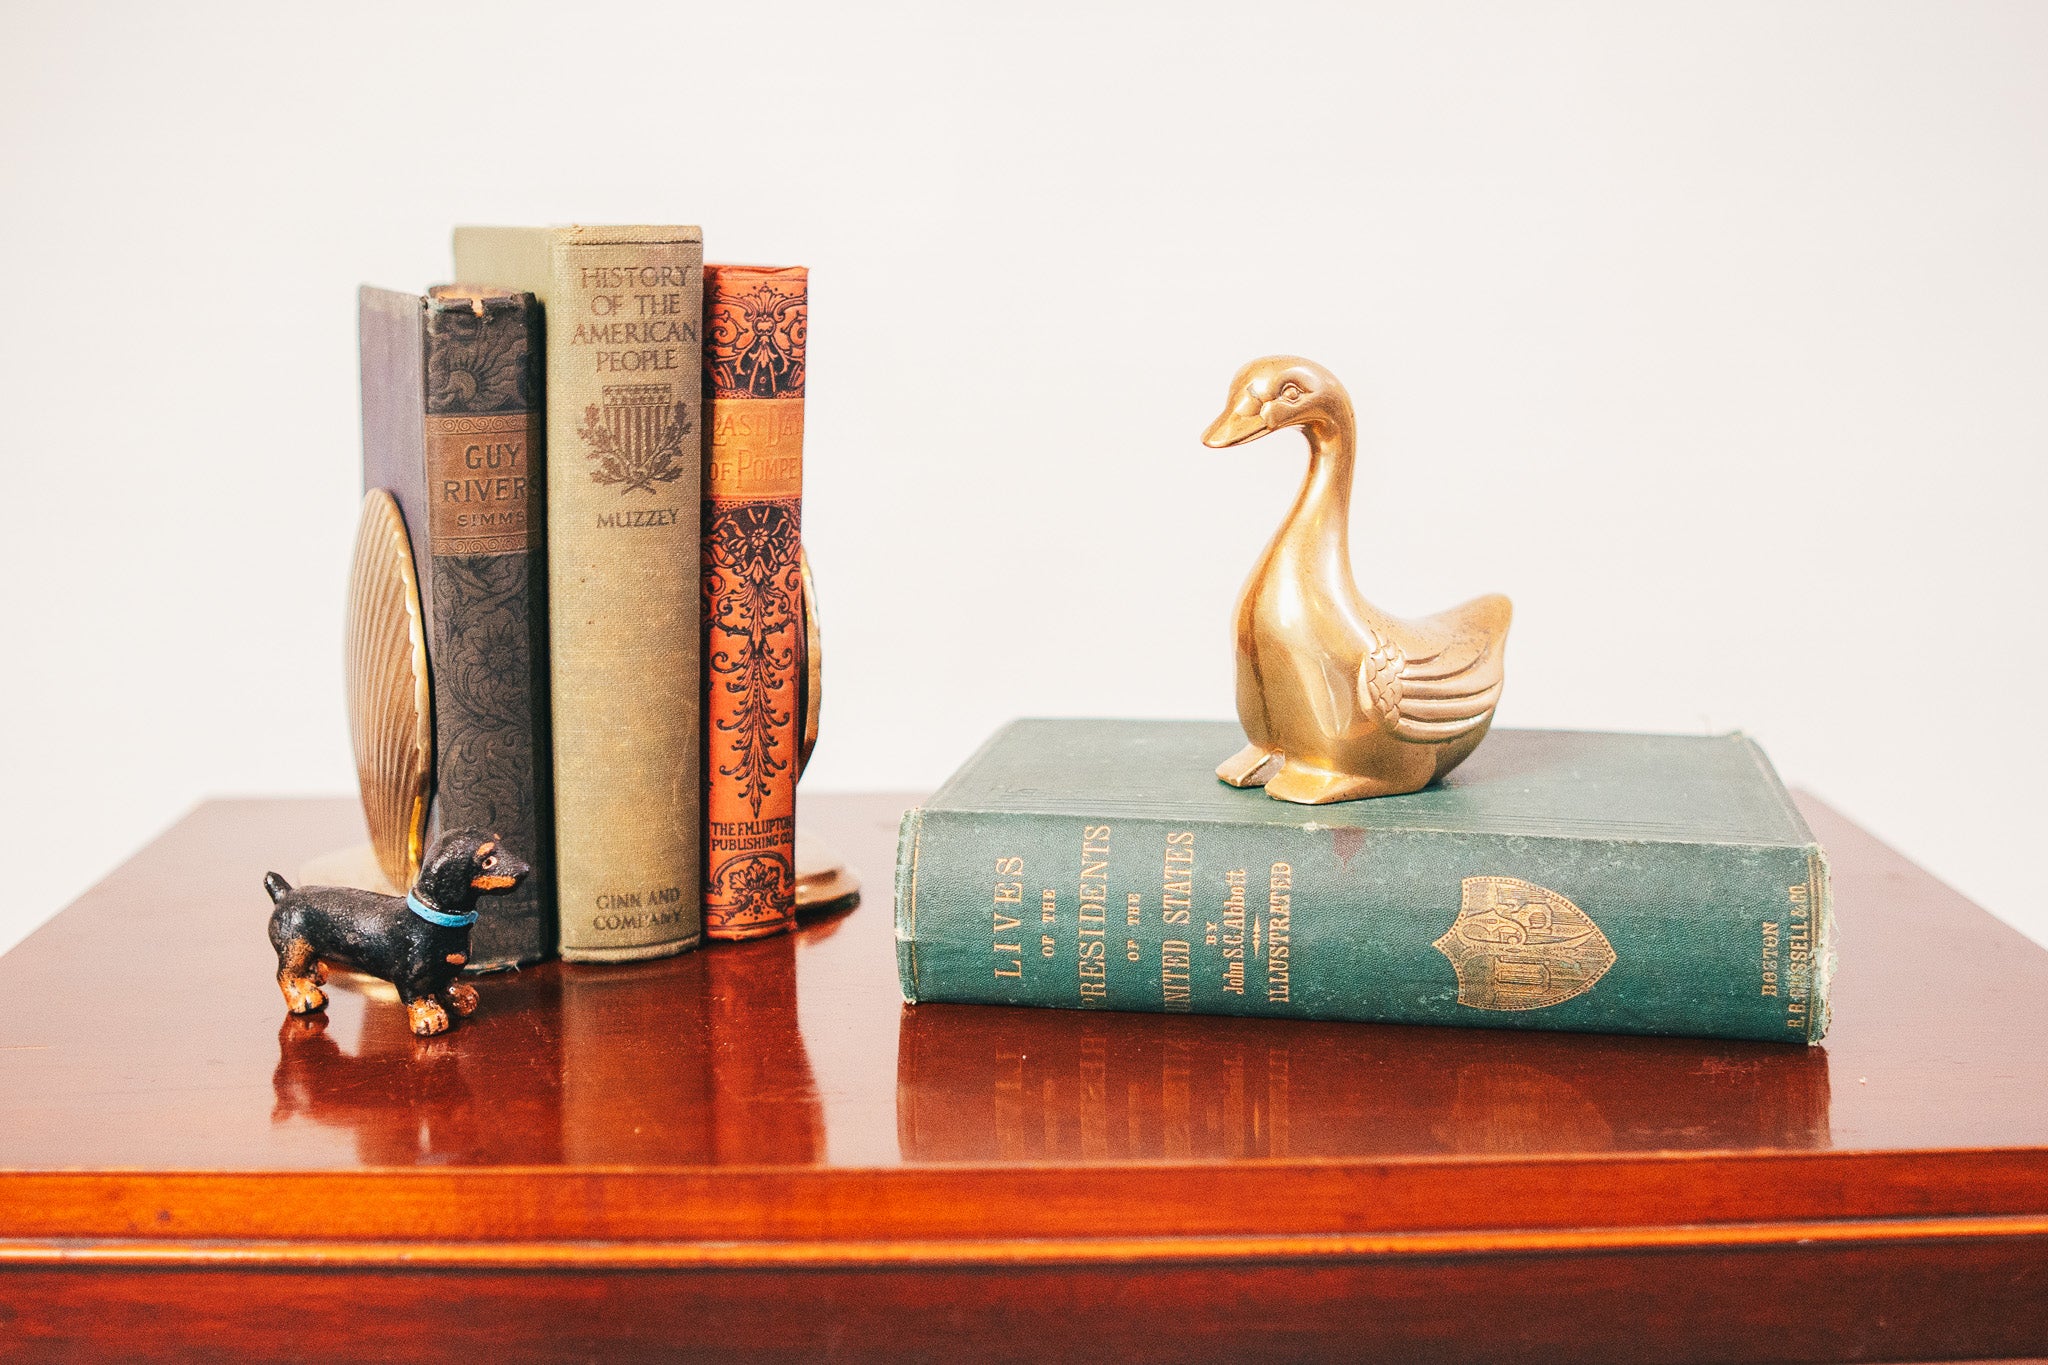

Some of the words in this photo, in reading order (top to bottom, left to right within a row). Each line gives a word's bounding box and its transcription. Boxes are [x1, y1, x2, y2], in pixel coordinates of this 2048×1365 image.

[582, 265, 691, 289] HISTORY
[590, 294, 624, 316] OF
[634, 293, 681, 315] THE
[570, 321, 698, 345] AMERICAN
[596, 349, 679, 373] PEOPLE
[465, 443, 521, 470] GUY
[709, 462, 734, 481] OF
[457, 510, 526, 528] SIMMS
[596, 509, 680, 529] MUZZEY
[711, 822, 736, 837] THE
[711, 834, 779, 852] PUBLISHING
[1163, 832, 1195, 925] STATES
[595, 893, 642, 910] GINN
[648, 887, 681, 906] AND
[1041, 888, 1056, 924] THE
[1127, 893, 1141, 926] THE
[592, 910, 681, 931] COMPANY
[993, 856, 1024, 979] LIVES
[1790, 904, 1809, 918] &
[1206, 921, 1219, 946] BY
[1268, 861, 1293, 1003] ILLUSTRATED
[1041, 934, 1056, 959] OF
[1127, 939, 1141, 962] OF
[1761, 921, 1779, 997] BOSTON
[1162, 940, 1191, 1012] UNITED
[1222, 961, 1244, 996] John
